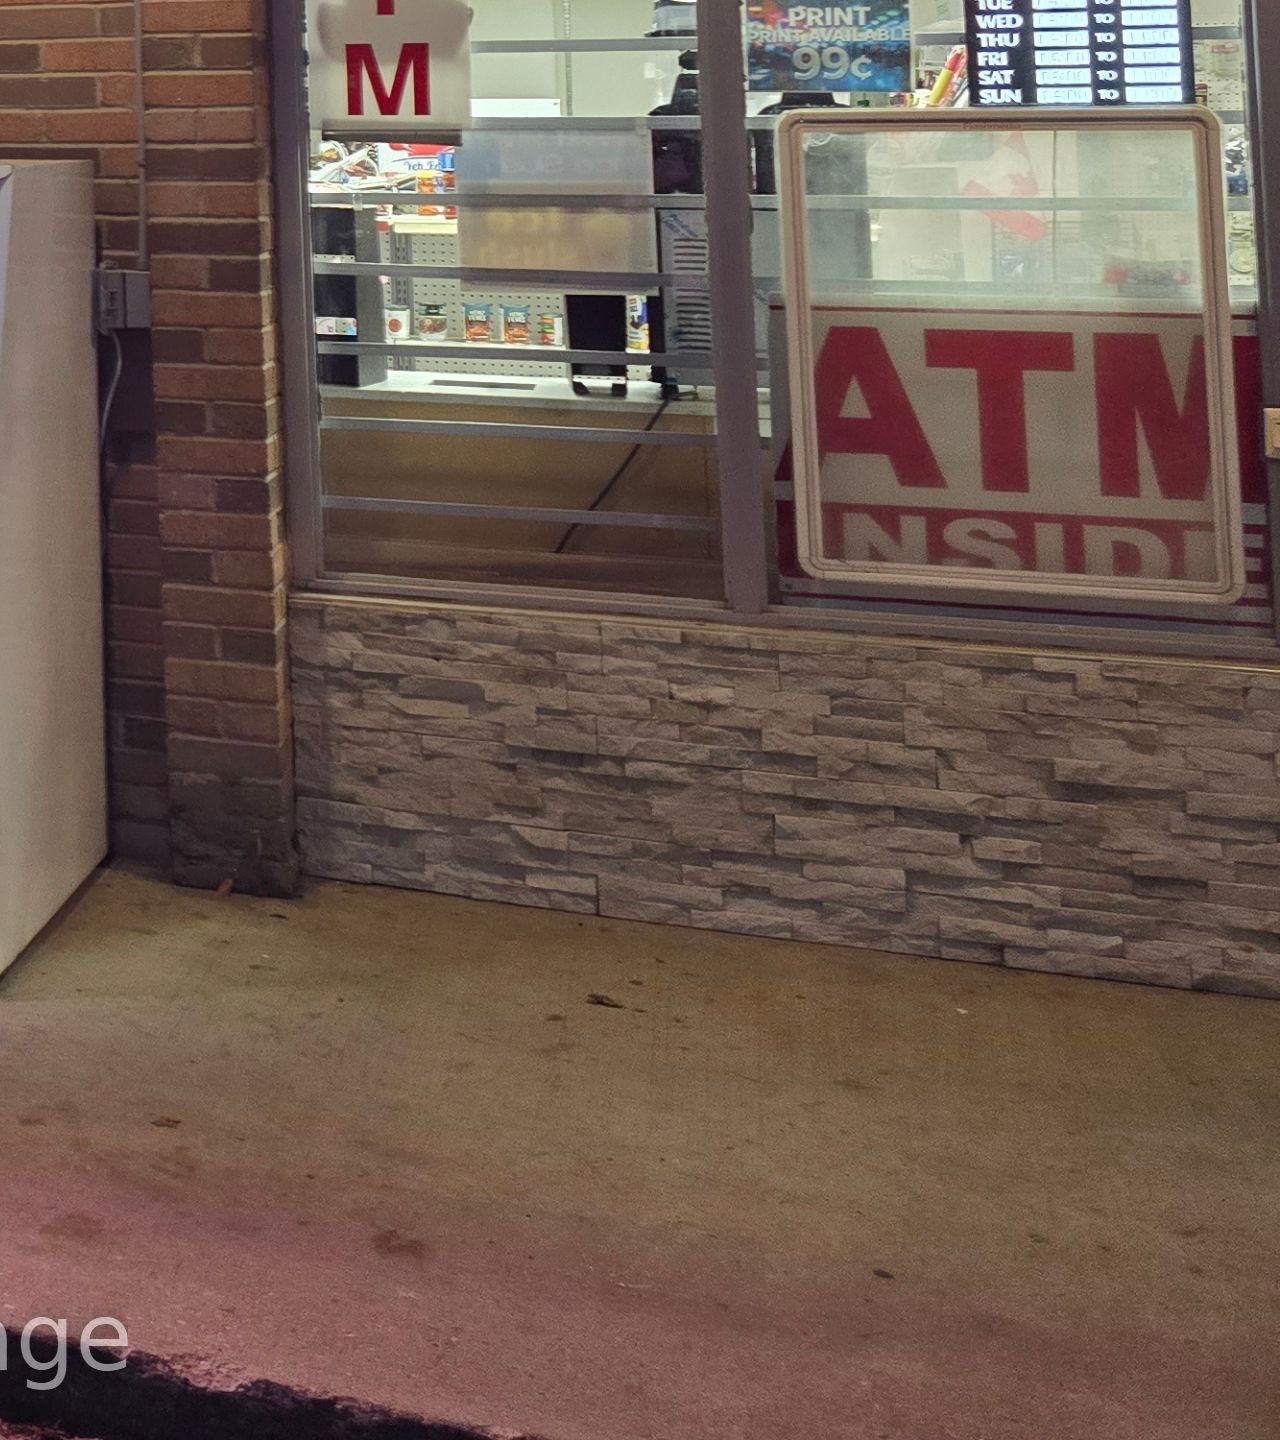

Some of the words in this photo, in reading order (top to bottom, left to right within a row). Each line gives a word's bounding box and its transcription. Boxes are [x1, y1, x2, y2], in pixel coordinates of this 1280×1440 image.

[788, 6, 872, 27] PRINT
[974, 13, 1024, 29] WED
[748, 29, 802, 43] PRINT
[806, 27, 912, 42] AVAILABLE
[975, 32, 1021, 48] THU
[792, 45, 873, 81] 99¢
[976, 50, 1009, 67] FRI
[977, 69, 1015, 86] SAT
[978, 88, 1023, 104] SUN
[774, 326, 1268, 505] ATM
[820, 513, 1268, 599] NSIDE
